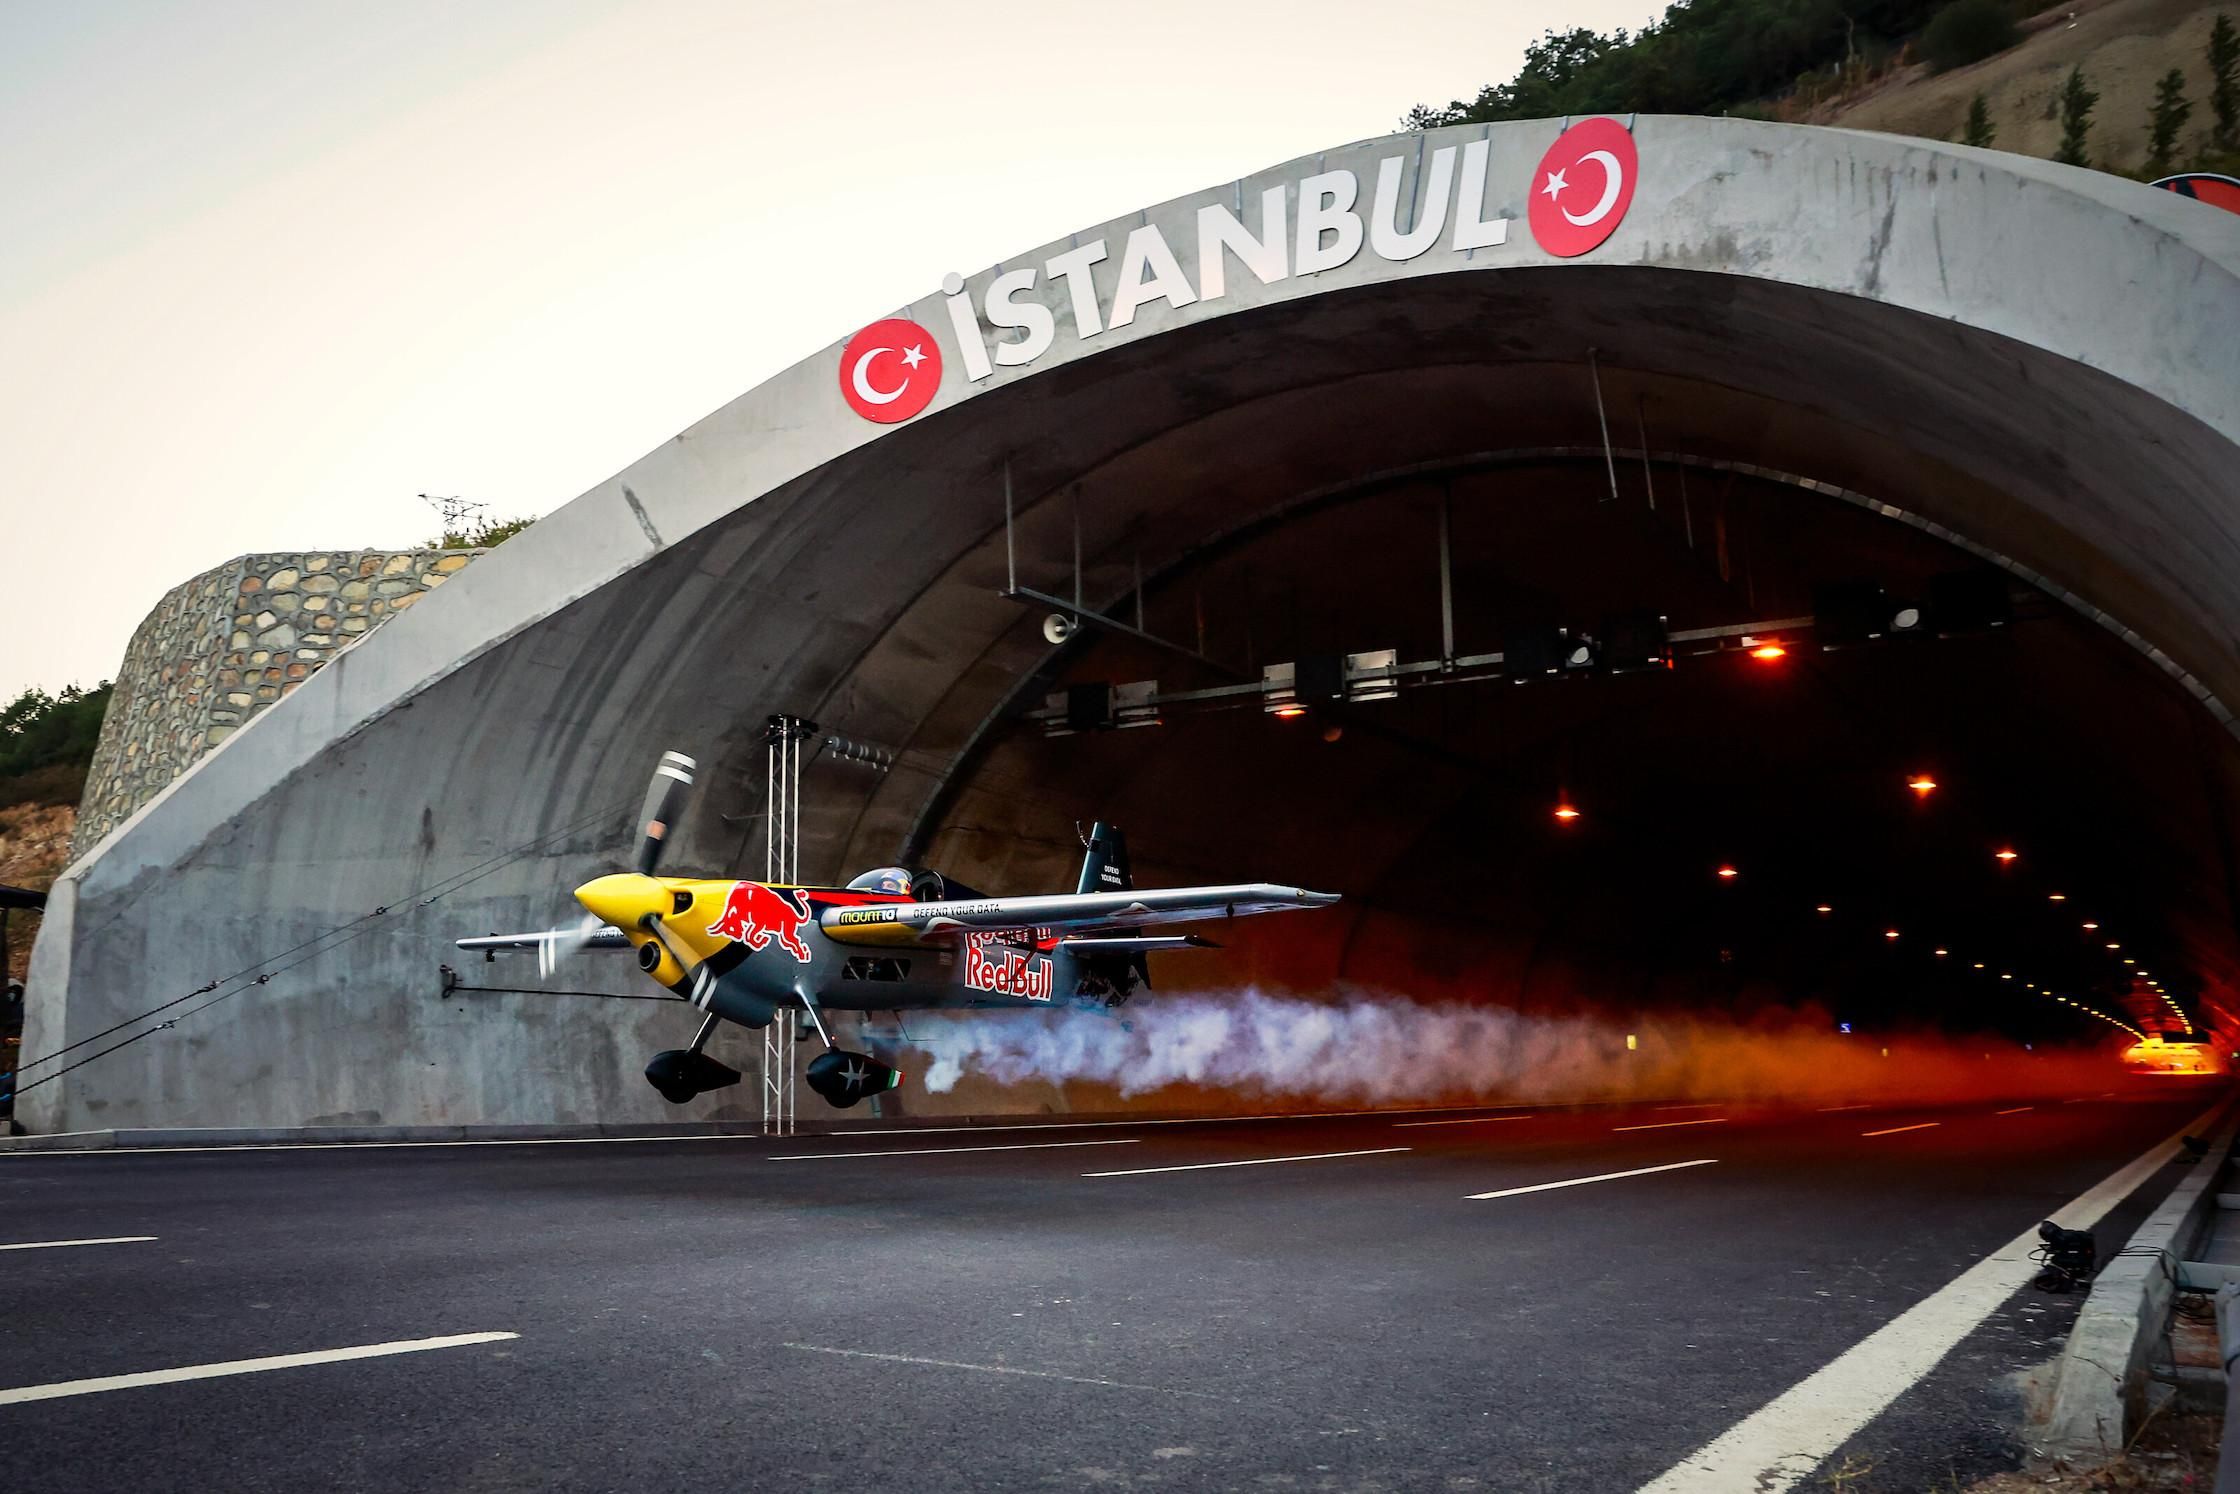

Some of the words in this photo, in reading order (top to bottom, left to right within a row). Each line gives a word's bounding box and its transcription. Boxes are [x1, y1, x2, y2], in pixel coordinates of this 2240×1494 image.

[1104, 865, 1120, 875] DEFEND
[913, 907, 948, 919] DEFEND
[950, 905, 975, 916] YOUR
